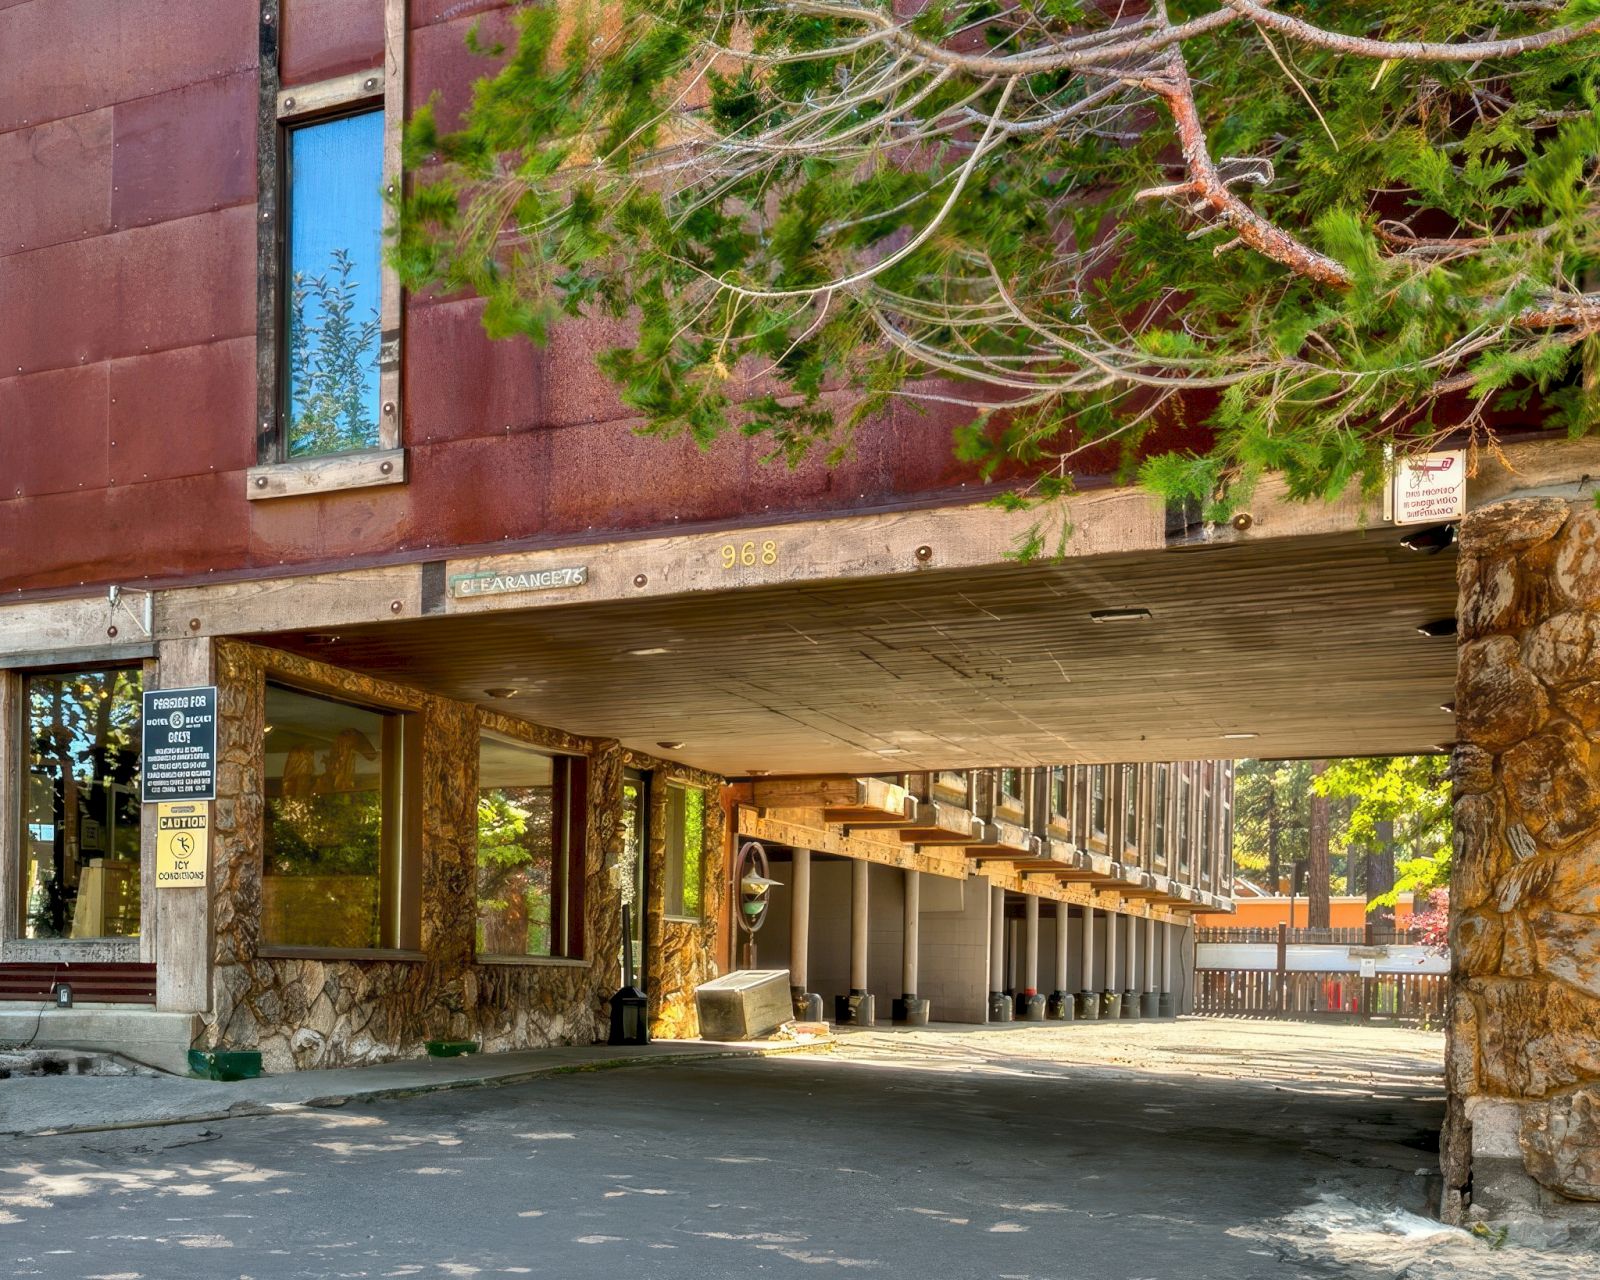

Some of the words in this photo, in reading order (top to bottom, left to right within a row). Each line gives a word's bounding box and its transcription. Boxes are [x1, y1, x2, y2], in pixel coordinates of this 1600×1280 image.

[721, 540, 777, 569] 968
[160, 816, 206, 829] CAUTION
[174, 860, 190, 870] ICY
[158, 871, 204, 880] CONDITIONS
